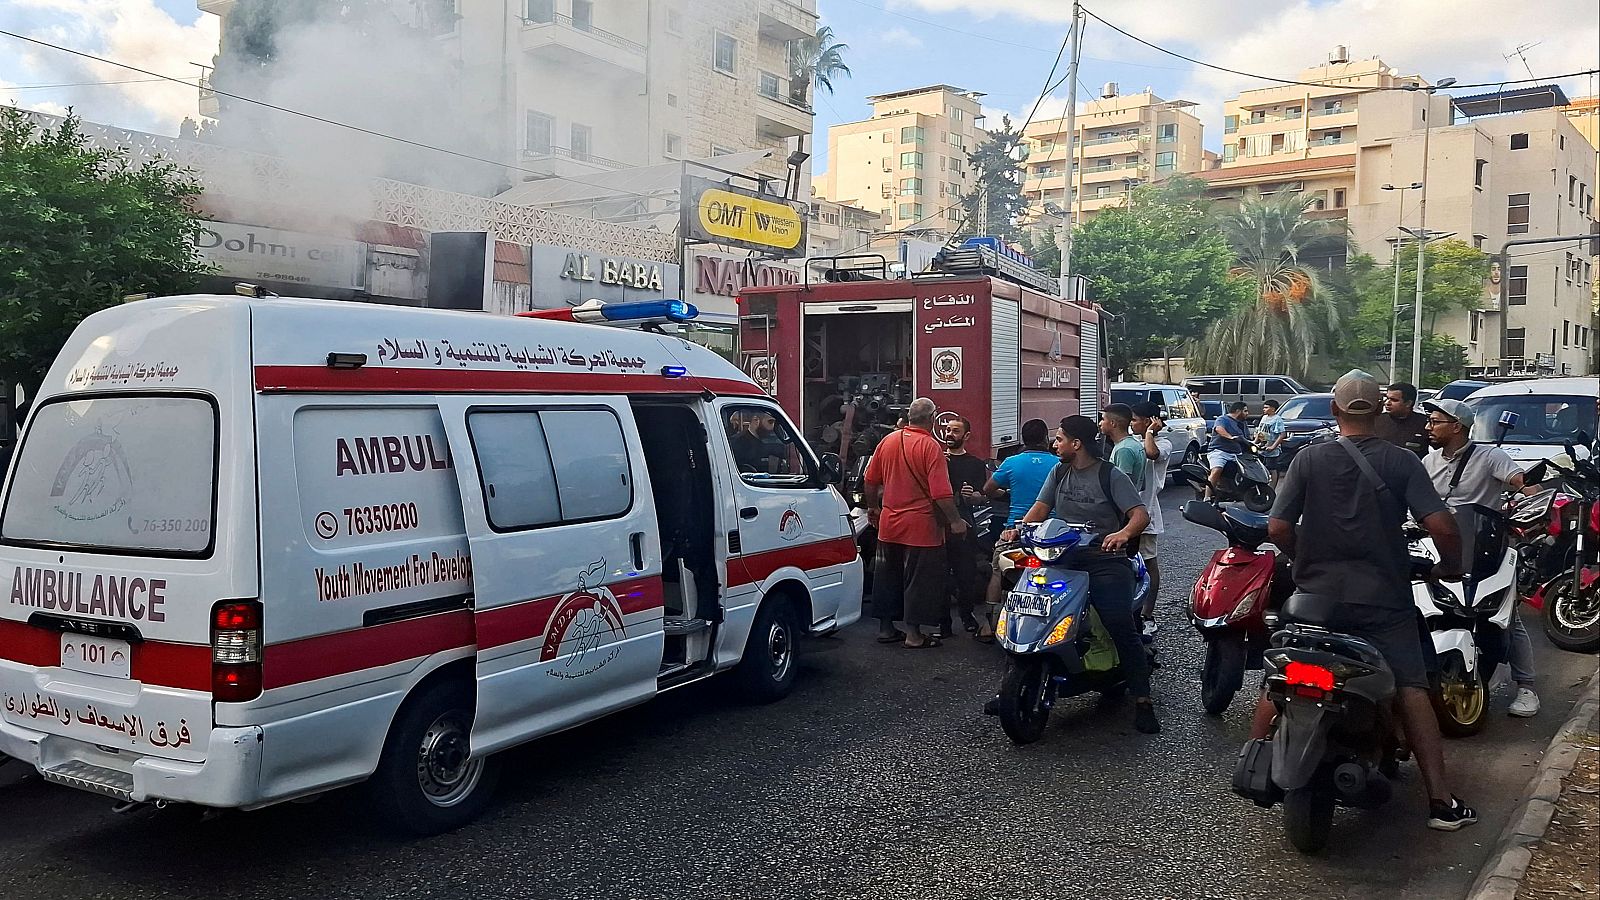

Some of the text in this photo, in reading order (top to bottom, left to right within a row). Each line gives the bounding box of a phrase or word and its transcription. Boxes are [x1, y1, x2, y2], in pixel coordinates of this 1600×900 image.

[707, 200, 747, 228] OMT
[771, 215, 795, 229] Western
[771, 224, 789, 236] Union
[560, 253, 664, 291] AL BABA
[377, 337, 429, 365] السلام
[434, 344, 442, 365] و
[441, 338, 501, 367] للتنمية
[501, 342, 559, 370] الشبابية
[559, 346, 610, 371] الحركة
[143, 519, 208, 532] 76-350 200
[343, 502, 418, 536] 76350200
[314, 564, 351, 602] Youth
[353, 556, 412, 596] Movement
[412, 554, 430, 587] For
[10, 566, 167, 623] AMBULANCE
[80, 643, 106, 664] 101
[76, 703, 144, 745] الإسعاف
[149, 719, 192, 749] فرق
